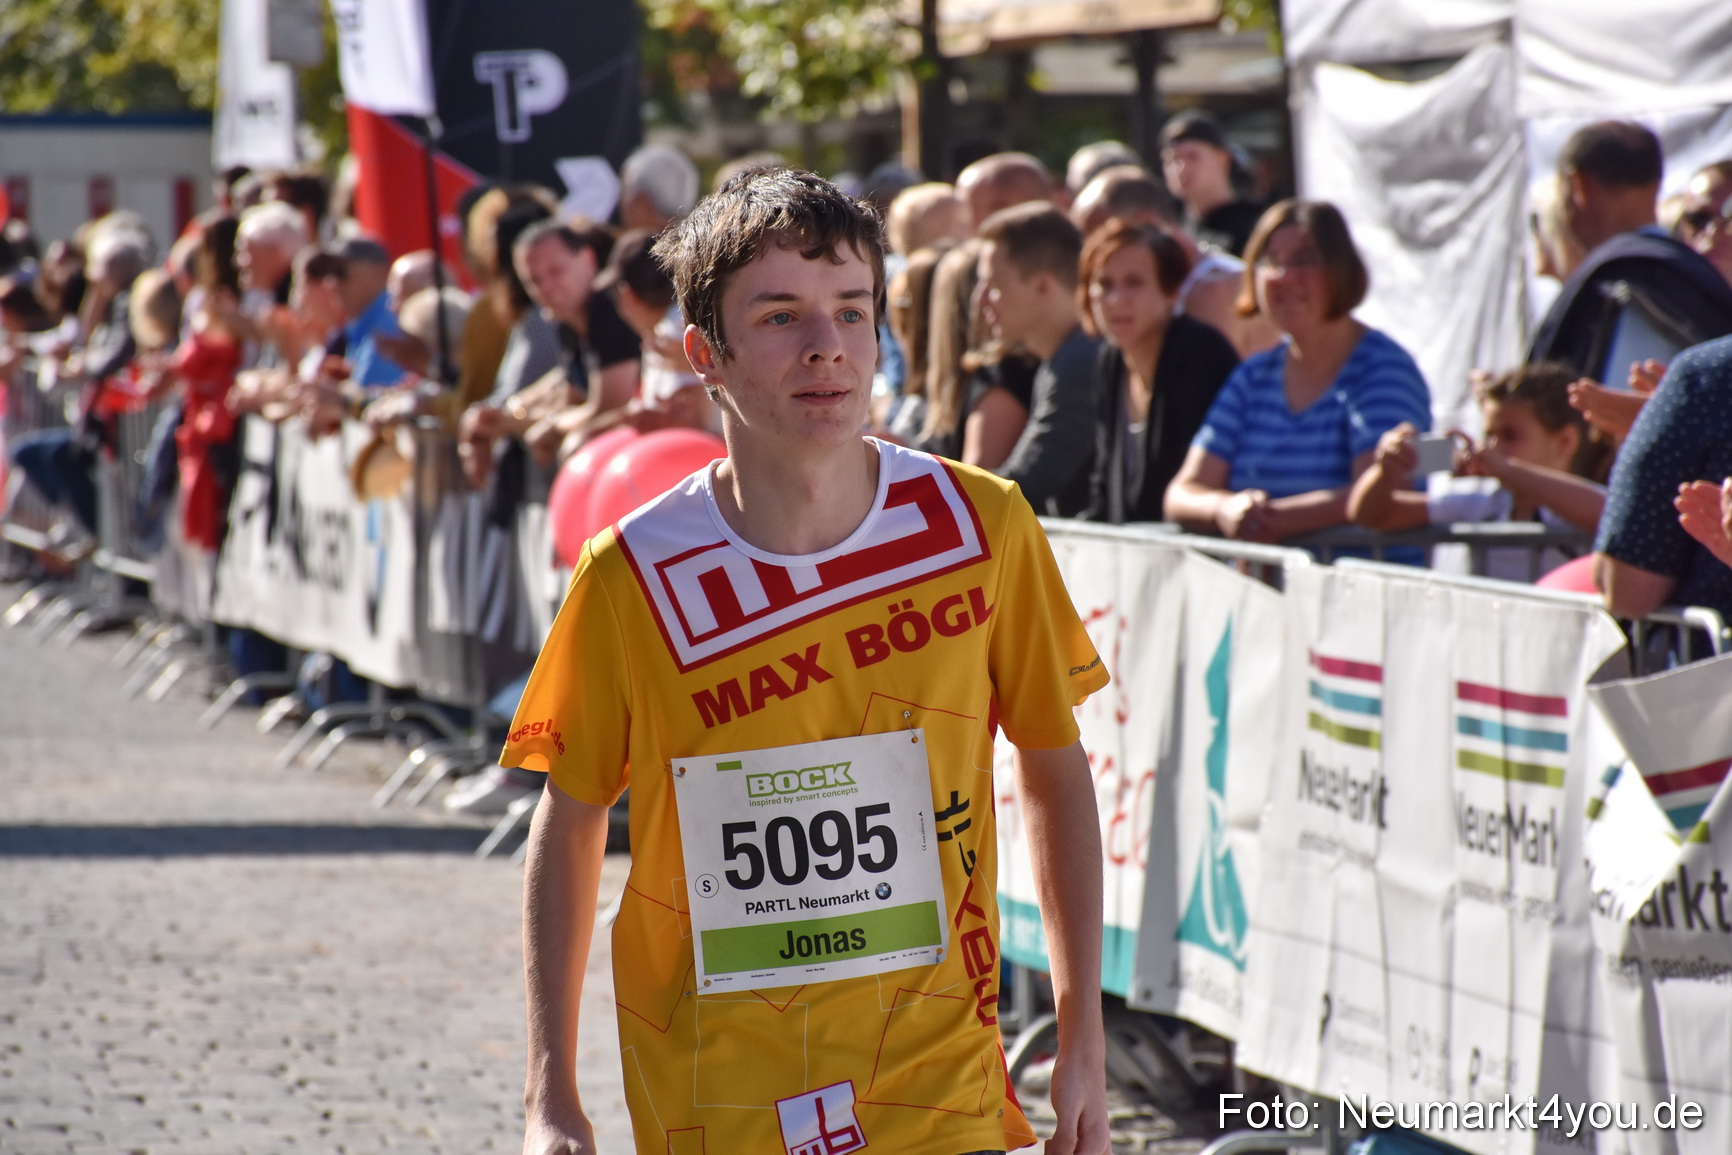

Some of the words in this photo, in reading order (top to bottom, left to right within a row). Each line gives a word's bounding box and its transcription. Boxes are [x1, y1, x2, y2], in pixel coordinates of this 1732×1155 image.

[691, 642, 834, 729] MAX
[845, 586, 995, 669] BÖGL
[506, 719, 564, 755] oegl.de
[746, 761, 856, 798] BOCK
[749, 797, 782, 808] inspired
[784, 796, 794, 805] by
[796, 793, 820, 802] smart
[822, 787, 859, 798] concepts
[722, 802, 898, 890] 5095
[702, 880, 712, 893] S
[745, 899, 796, 915] PARTL
[799, 889, 870, 909] Neumarkt
[779, 927, 866, 959] Jonas
